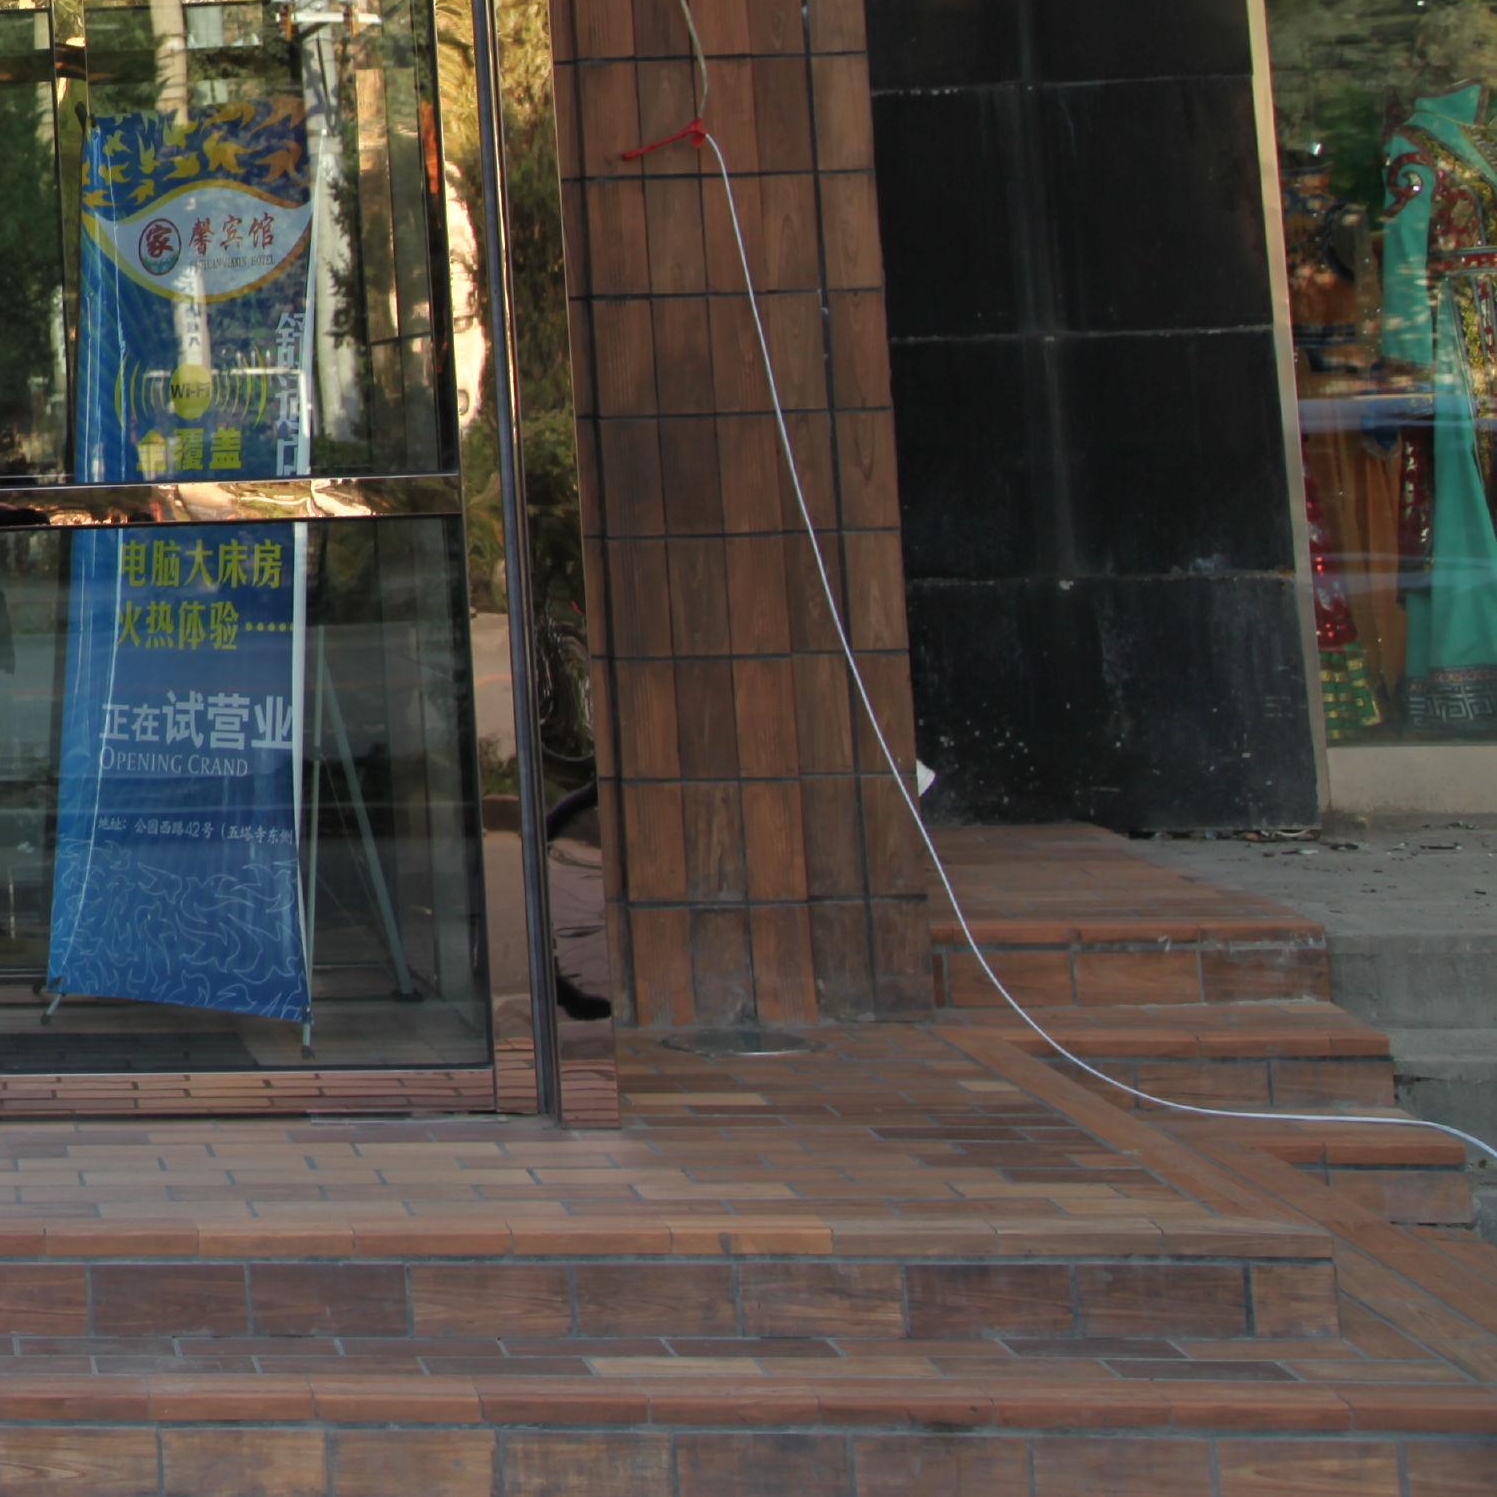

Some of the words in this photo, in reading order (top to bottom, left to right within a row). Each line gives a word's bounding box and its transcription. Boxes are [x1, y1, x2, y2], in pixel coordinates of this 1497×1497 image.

[189, 211, 276, 257] 馨宾馆
[171, 382, 211, 400] Wi-Fi
[137, 426, 243, 471] 全覆盖
[121, 538, 283, 589] 电脑大床房
[99, 690, 293, 750] 正在试营业
[100, 746, 183, 774] OPENING
